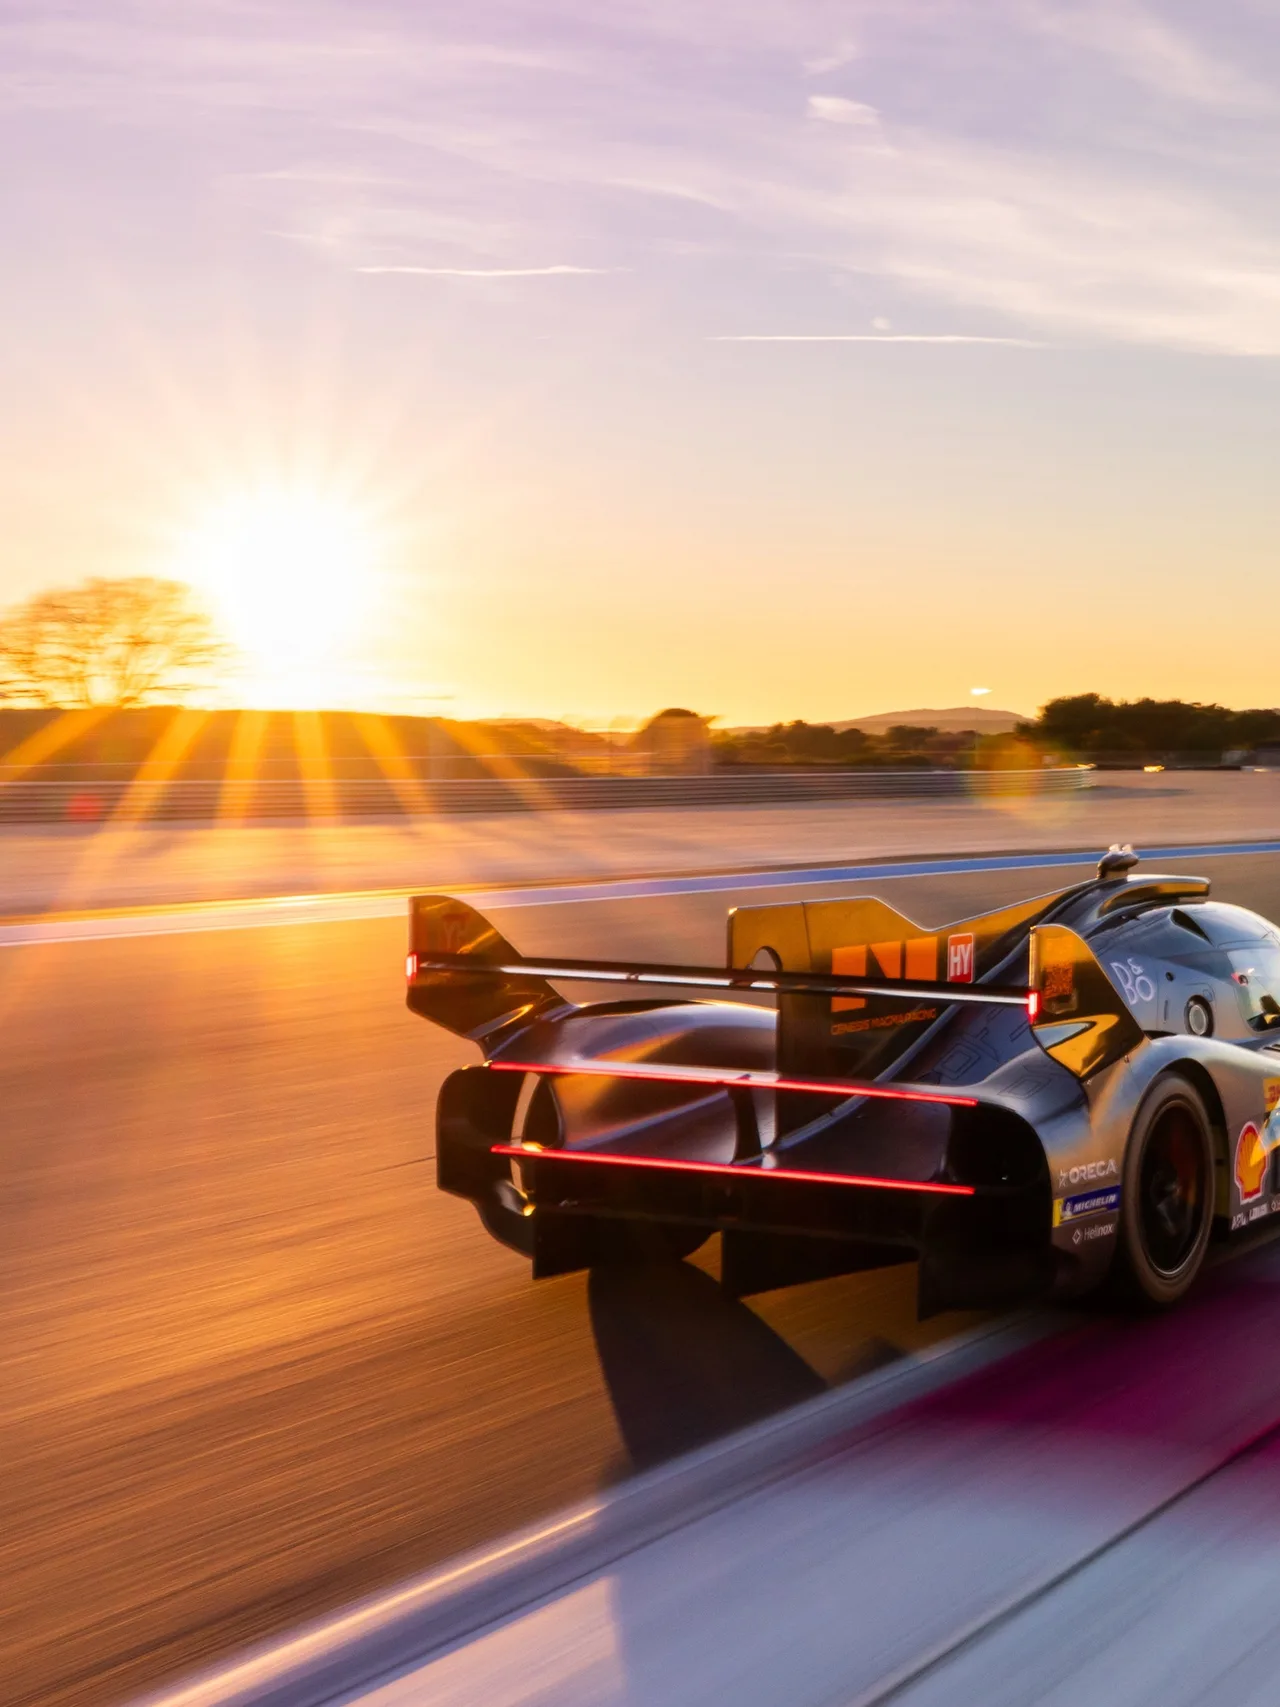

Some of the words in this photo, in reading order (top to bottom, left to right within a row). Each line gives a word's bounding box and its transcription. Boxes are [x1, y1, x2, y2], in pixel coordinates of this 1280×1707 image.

[950, 943, 972, 977] HY
[1069, 1159, 1117, 1184] ORECA
[1073, 1194, 1117, 1212] MICHELIN
[1084, 1223, 1116, 1241] Helinox
